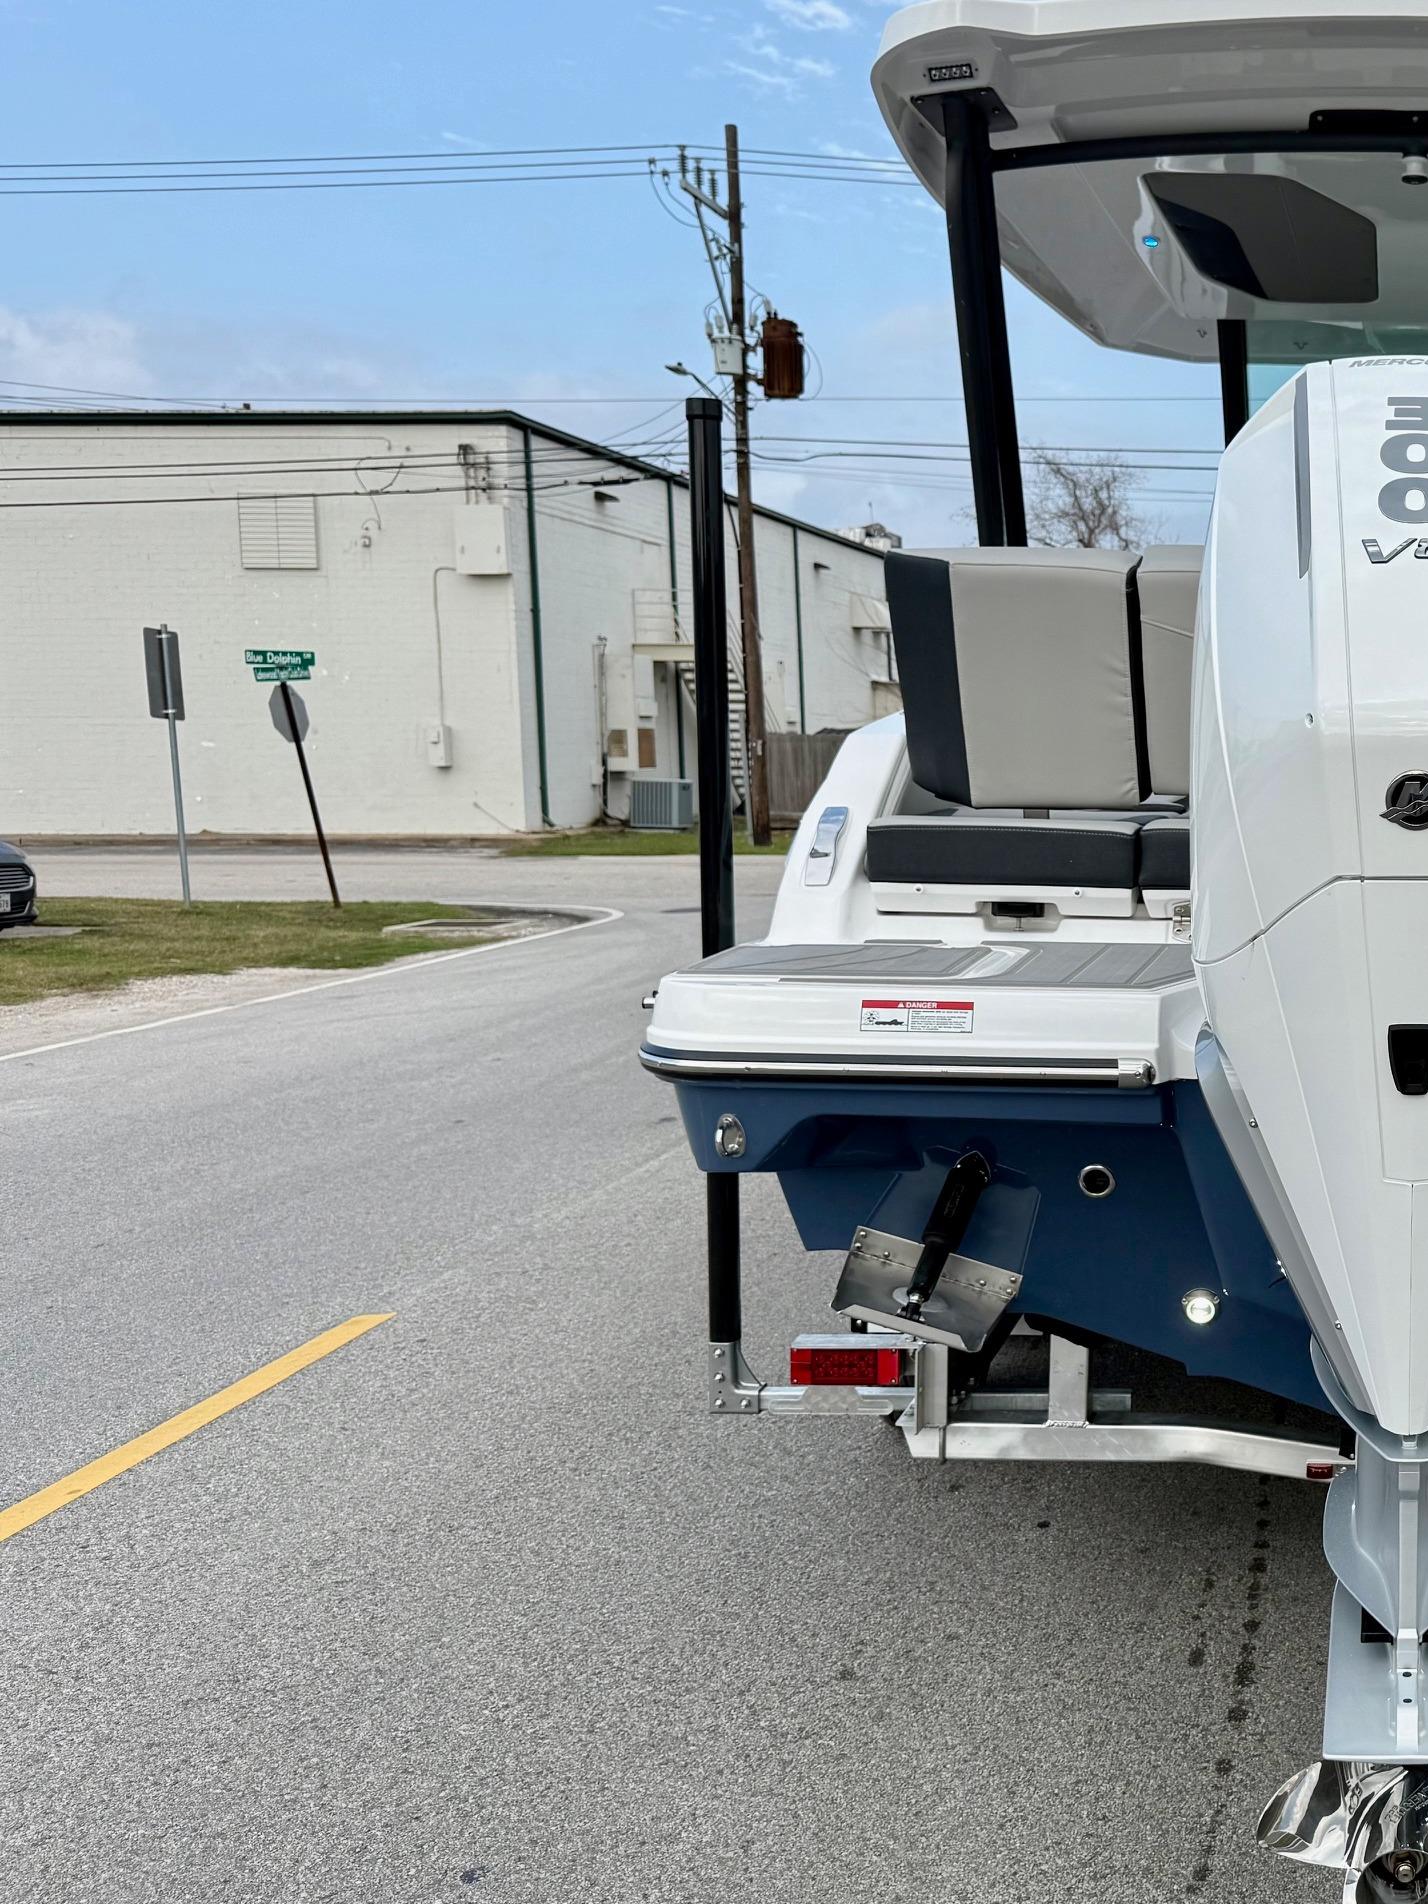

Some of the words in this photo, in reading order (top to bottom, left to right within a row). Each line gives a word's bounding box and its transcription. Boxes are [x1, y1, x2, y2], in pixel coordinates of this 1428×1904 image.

[246, 651, 263, 662] Blue
[266, 652, 301, 665] Dolphin
[905, 1001, 938, 1009] DANGER
